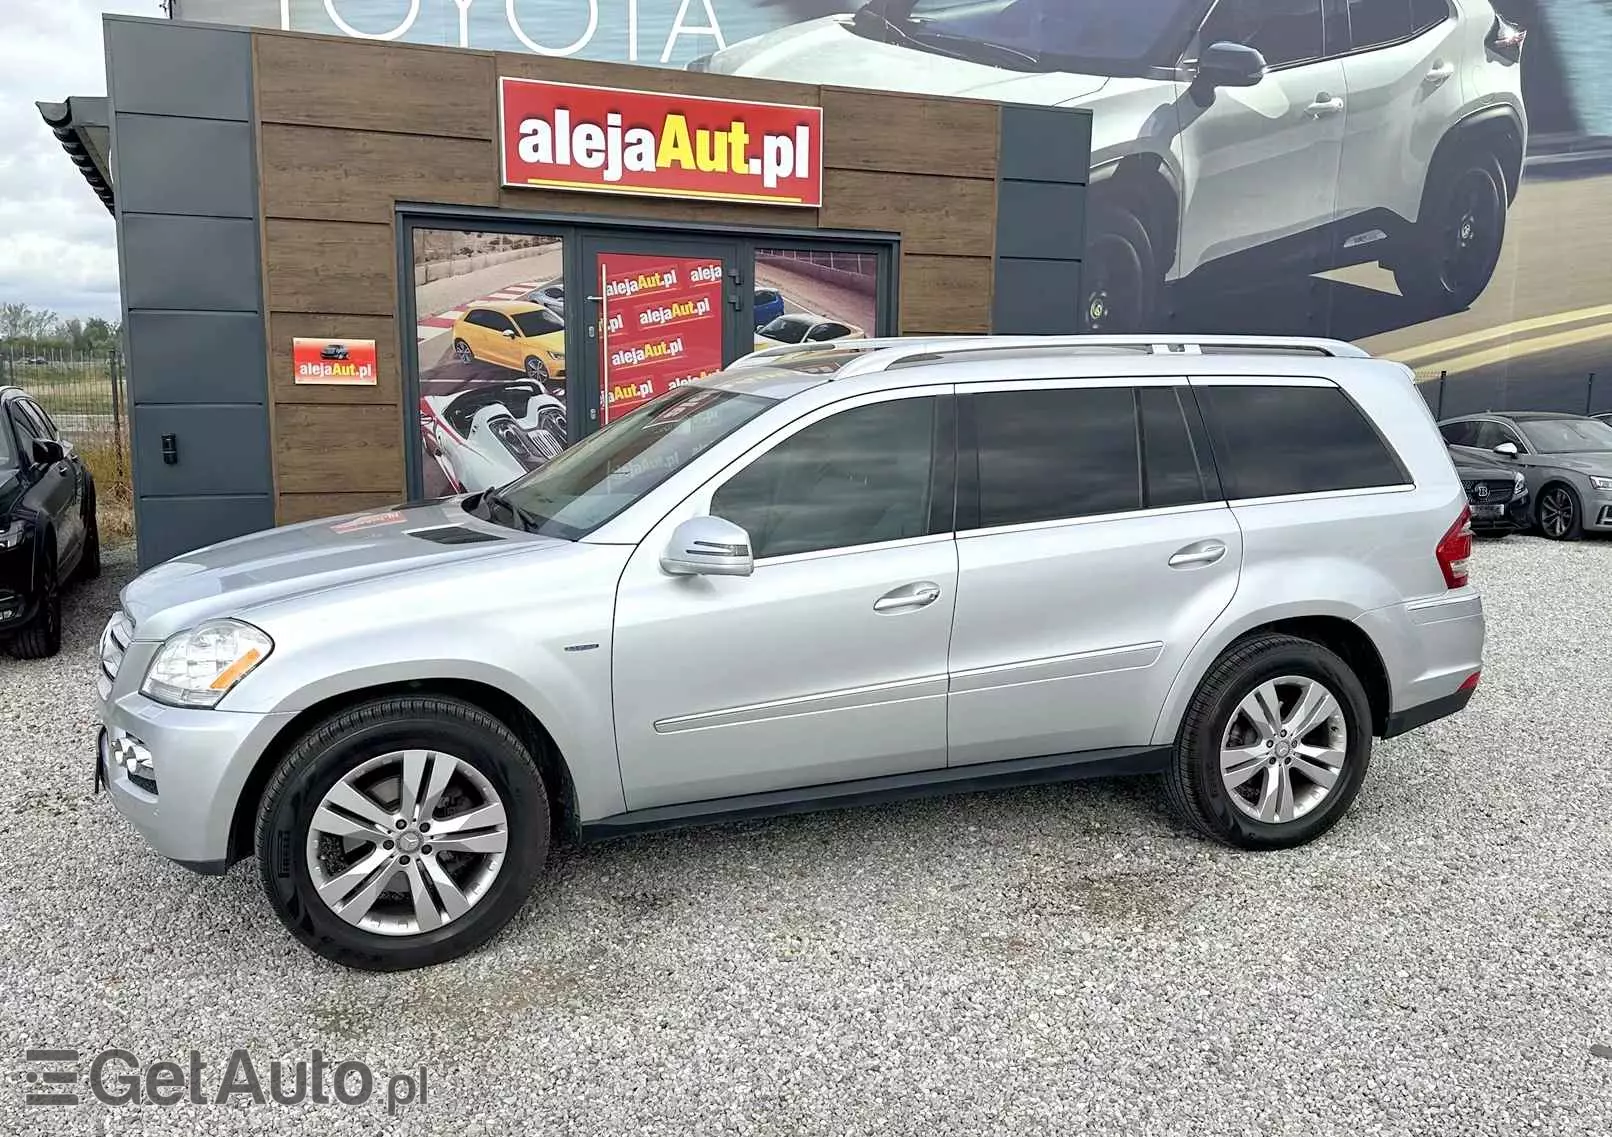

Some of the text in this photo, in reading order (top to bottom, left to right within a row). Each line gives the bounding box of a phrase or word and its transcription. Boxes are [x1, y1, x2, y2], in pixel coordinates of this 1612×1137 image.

[518, 109, 809, 188] alejaAut.pl
[606, 270, 677, 297] alejaAut.pl
[639, 298, 711, 325] alejaAut.pl
[612, 338, 683, 367] alejaAut.pl
[300, 363, 372, 380] alejaAut.pl
